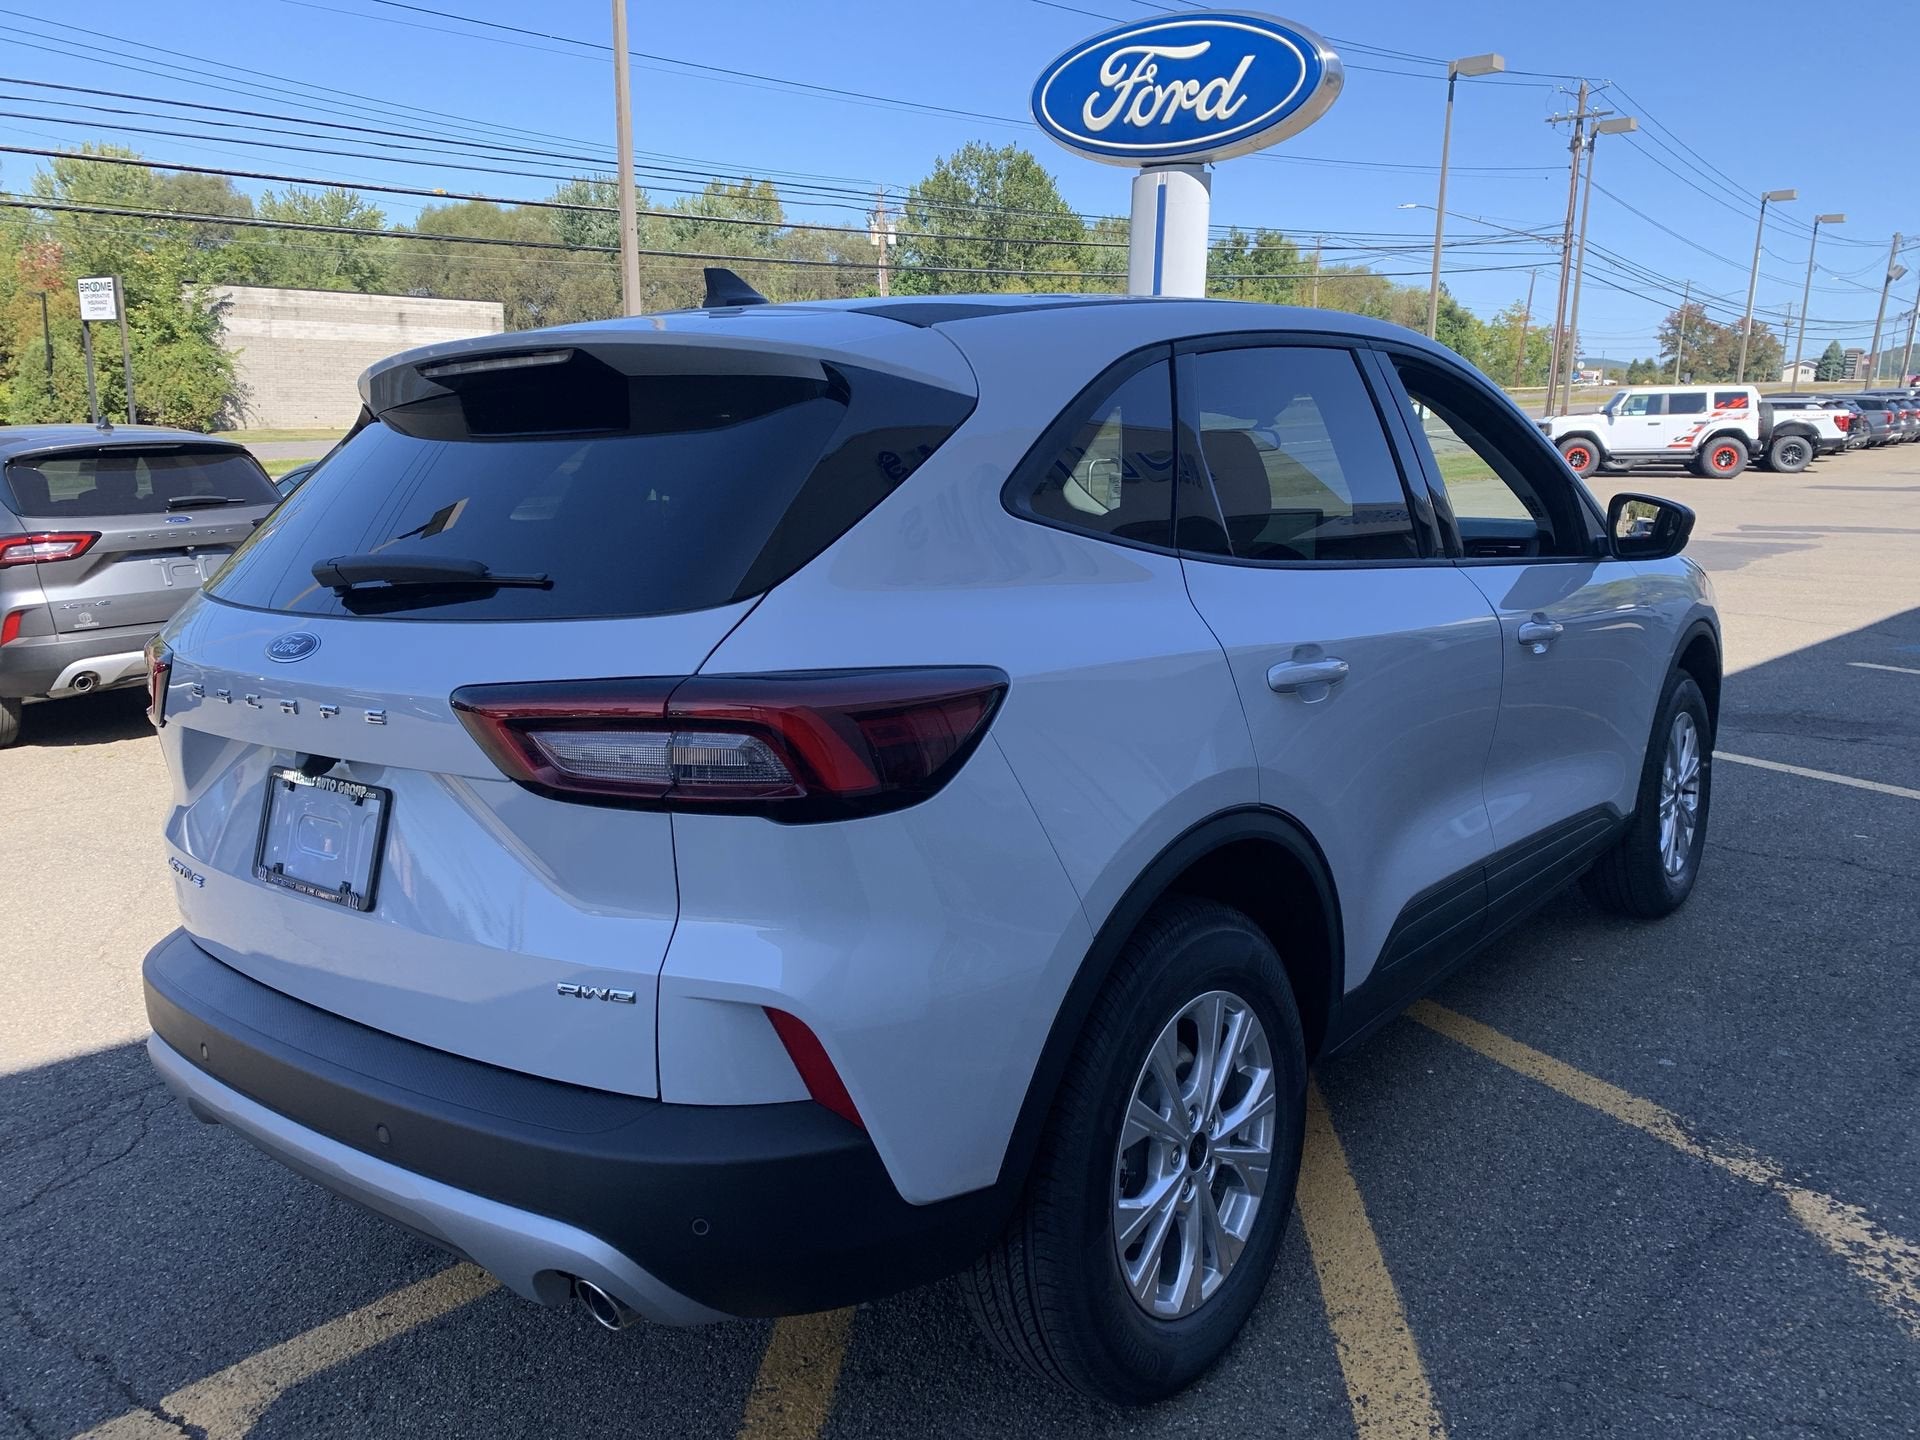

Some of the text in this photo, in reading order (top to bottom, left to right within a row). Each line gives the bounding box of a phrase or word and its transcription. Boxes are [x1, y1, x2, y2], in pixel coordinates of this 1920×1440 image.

[1083, 41, 1255, 131] Ford
[80, 282, 112, 292] BROOME
[272, 635, 306, 653] Ford
[191, 683, 388, 725] ESCAPE
[315, 776, 336, 792] AUTO
[556, 982, 636, 1004] AWD
